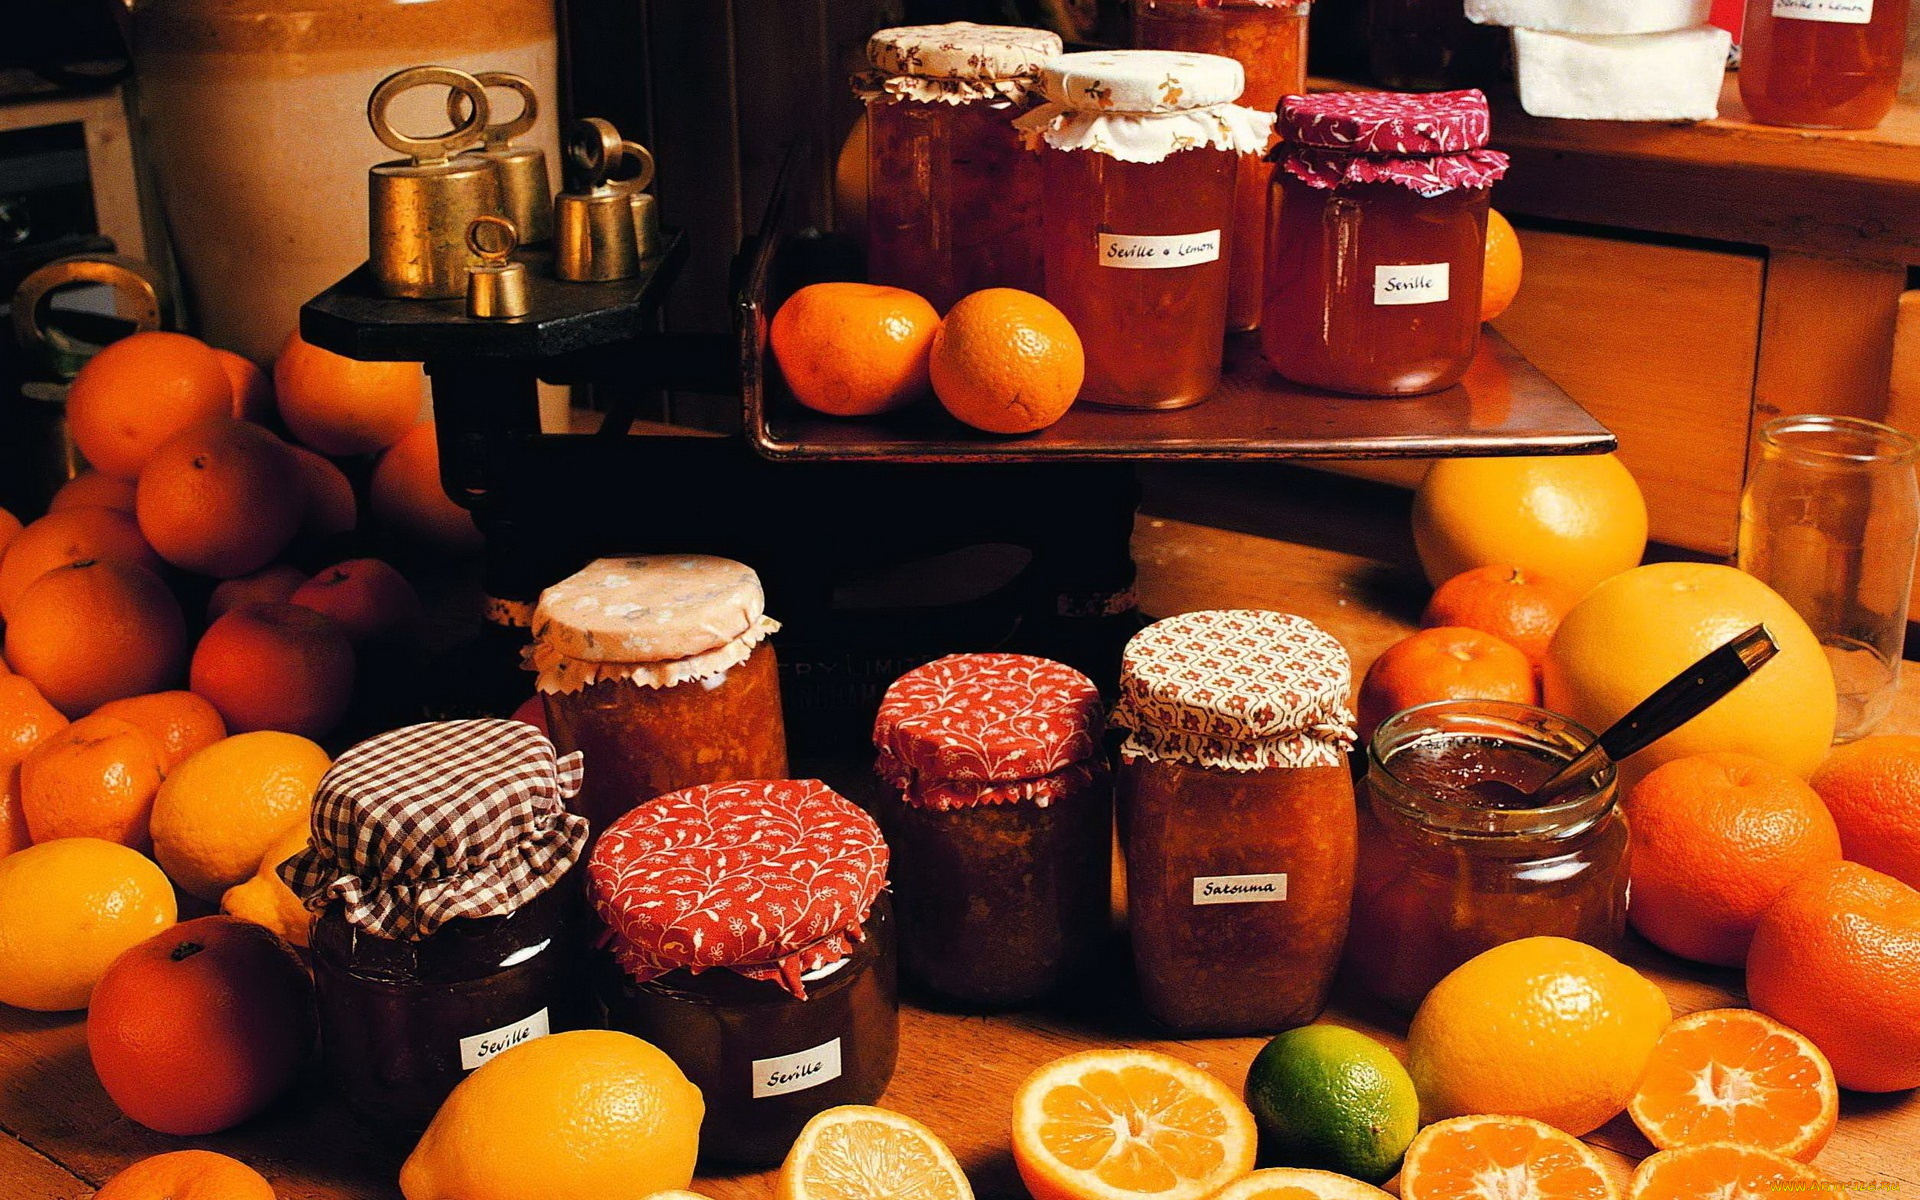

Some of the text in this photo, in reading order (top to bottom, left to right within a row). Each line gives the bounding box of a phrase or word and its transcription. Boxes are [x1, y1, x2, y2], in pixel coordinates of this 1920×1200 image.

[1107, 243, 1156, 258] Seville
[1178, 242, 1214, 256] Lemon
[1384, 275, 1434, 291] Seville
[1203, 882, 1277, 896] Satsuma
[477, 1027, 531, 1057] Seville
[767, 1061, 824, 1087] Seville
